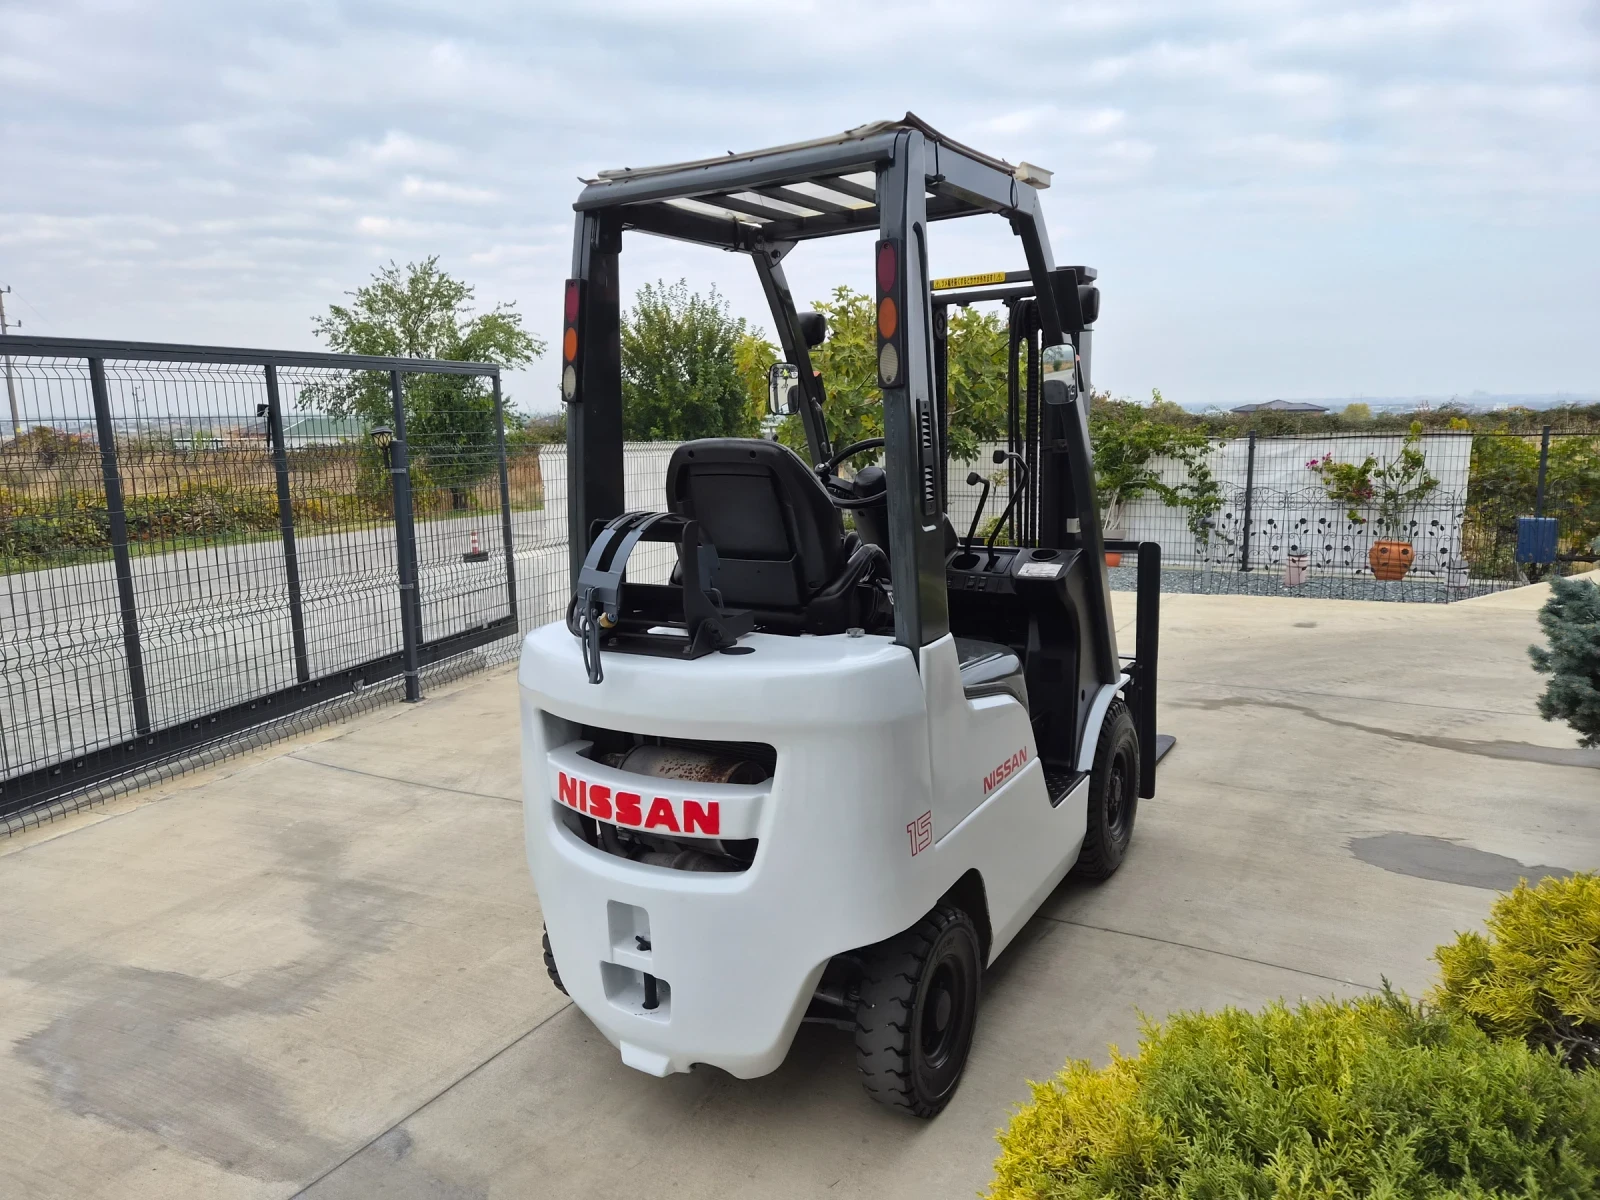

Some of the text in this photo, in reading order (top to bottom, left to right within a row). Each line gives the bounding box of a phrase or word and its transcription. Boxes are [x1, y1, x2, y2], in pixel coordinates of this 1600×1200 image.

[983, 745, 1028, 795] NISSAN
[558, 771, 720, 836] NISSAN
[906, 809, 933, 857] 15
